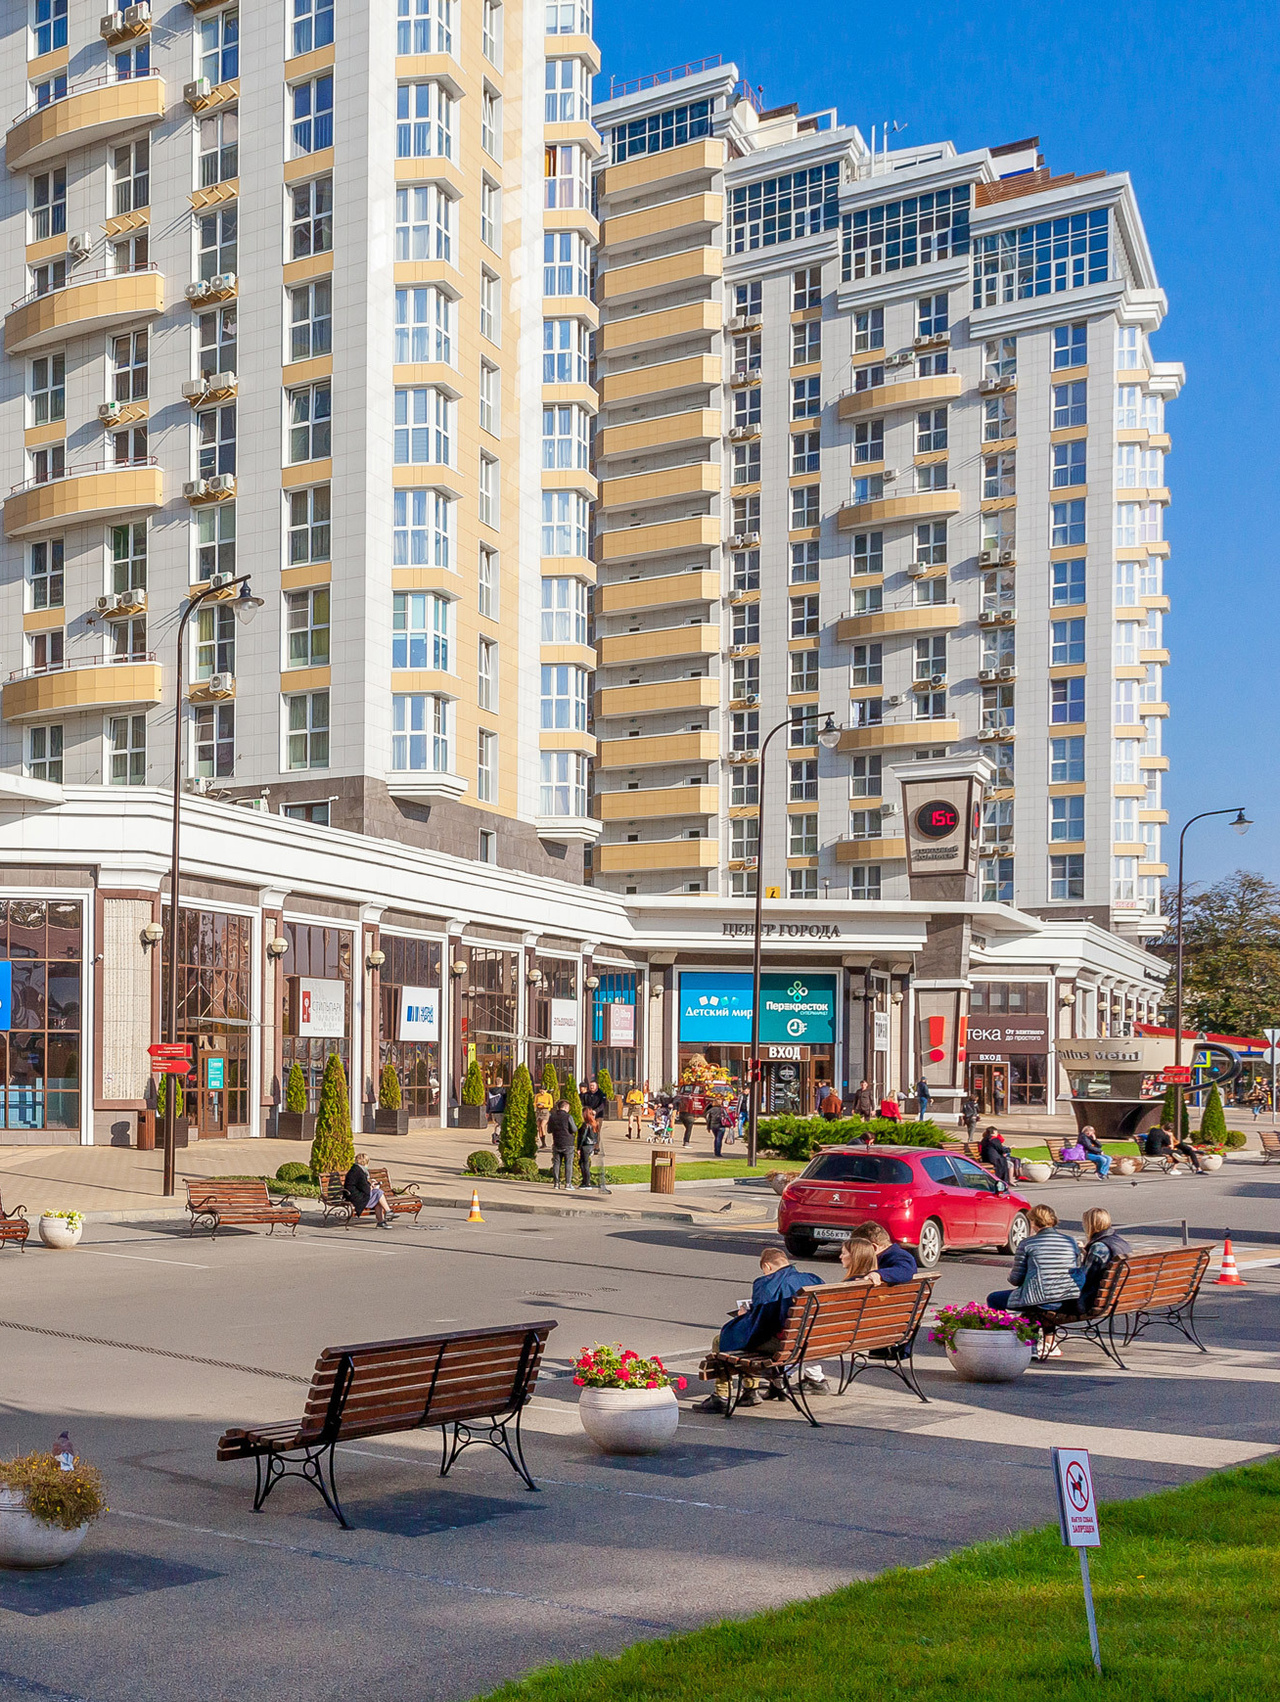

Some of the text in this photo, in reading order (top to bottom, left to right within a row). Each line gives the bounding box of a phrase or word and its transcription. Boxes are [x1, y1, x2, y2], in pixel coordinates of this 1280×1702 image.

[778, 924, 841, 939] ГОРОДА
[685, 1006, 753, 1020] Детский мир
[766, 1001, 829, 1012] Перекресток
[769, 1046, 801, 1060] ВХОД
